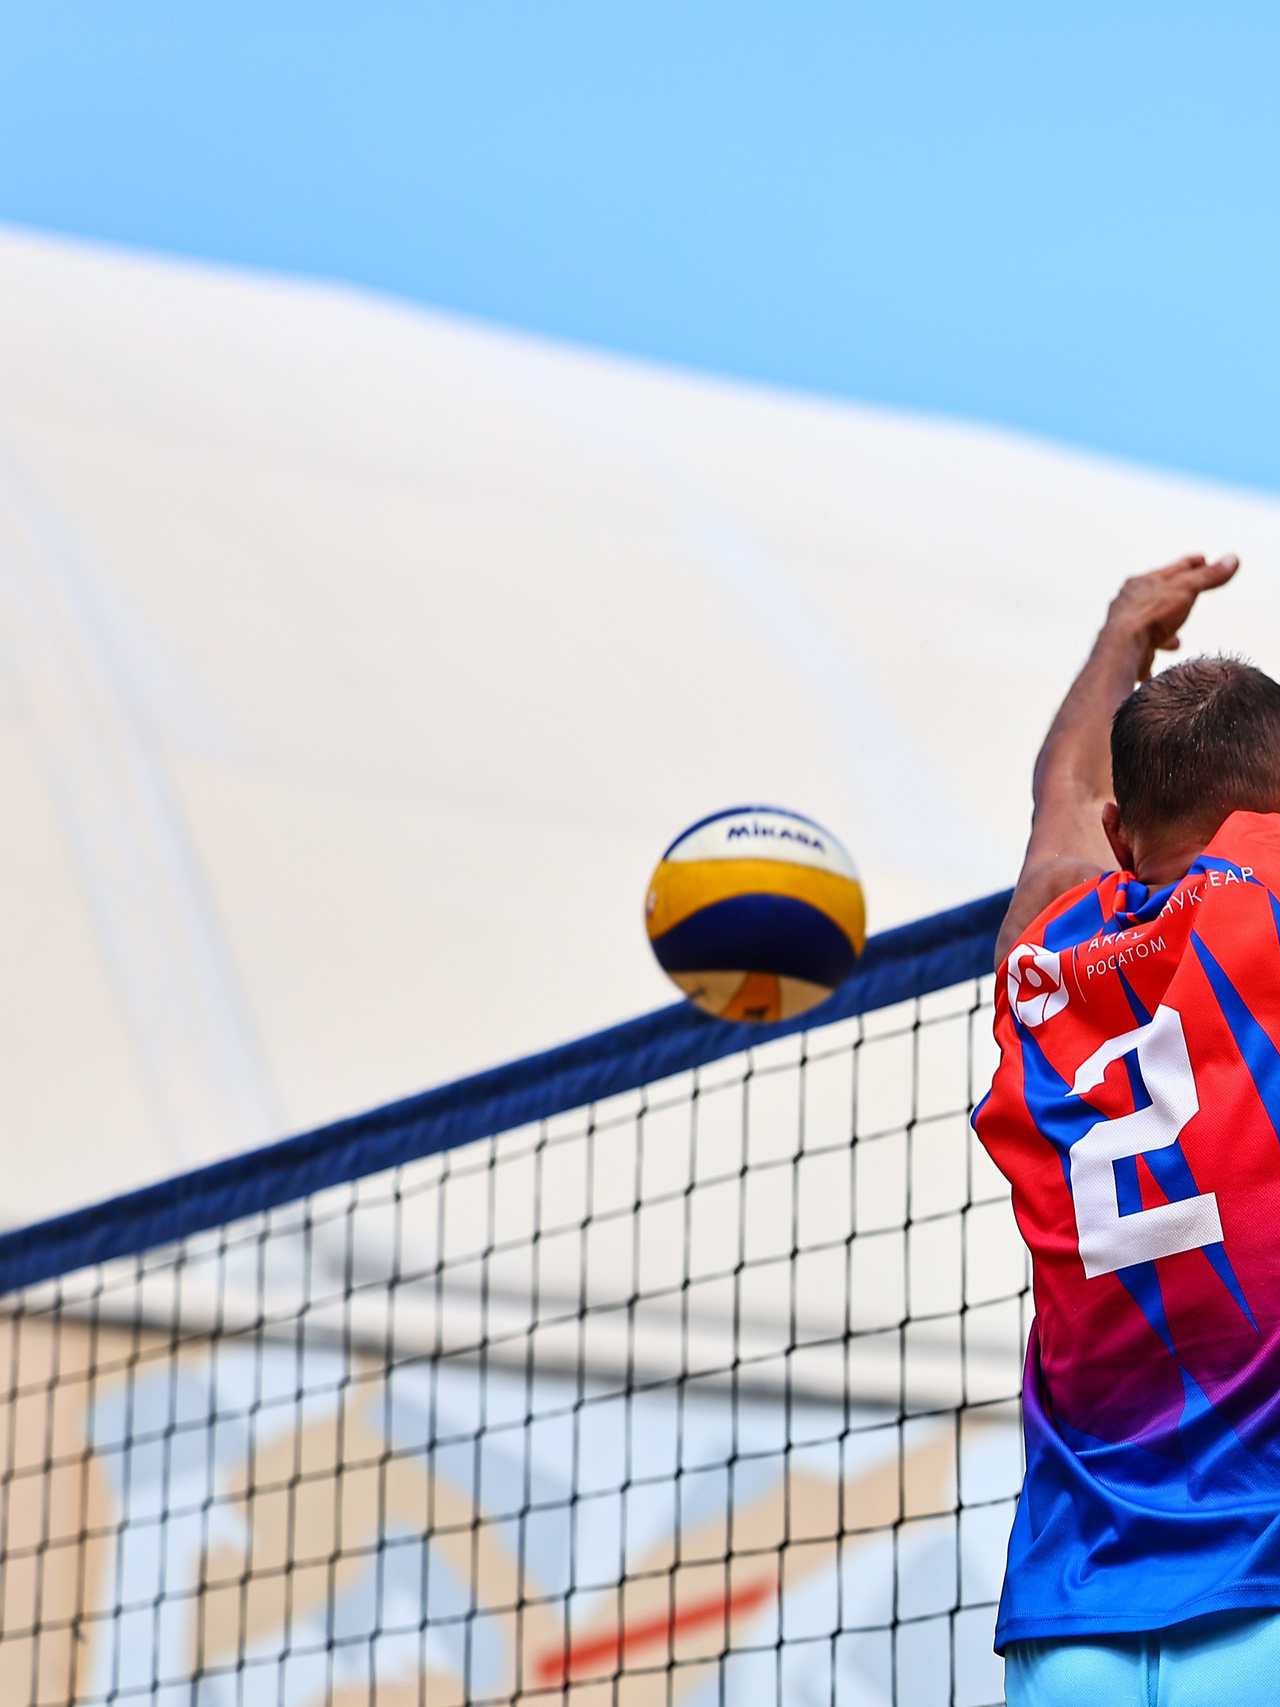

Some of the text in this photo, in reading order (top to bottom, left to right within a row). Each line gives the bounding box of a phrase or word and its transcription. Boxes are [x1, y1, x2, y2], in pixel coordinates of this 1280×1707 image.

[1159, 866, 1254, 918] НУКЕАР
[1086, 936, 1167, 980] РОСАТОМ
[1065, 1004, 1225, 1280] 2
